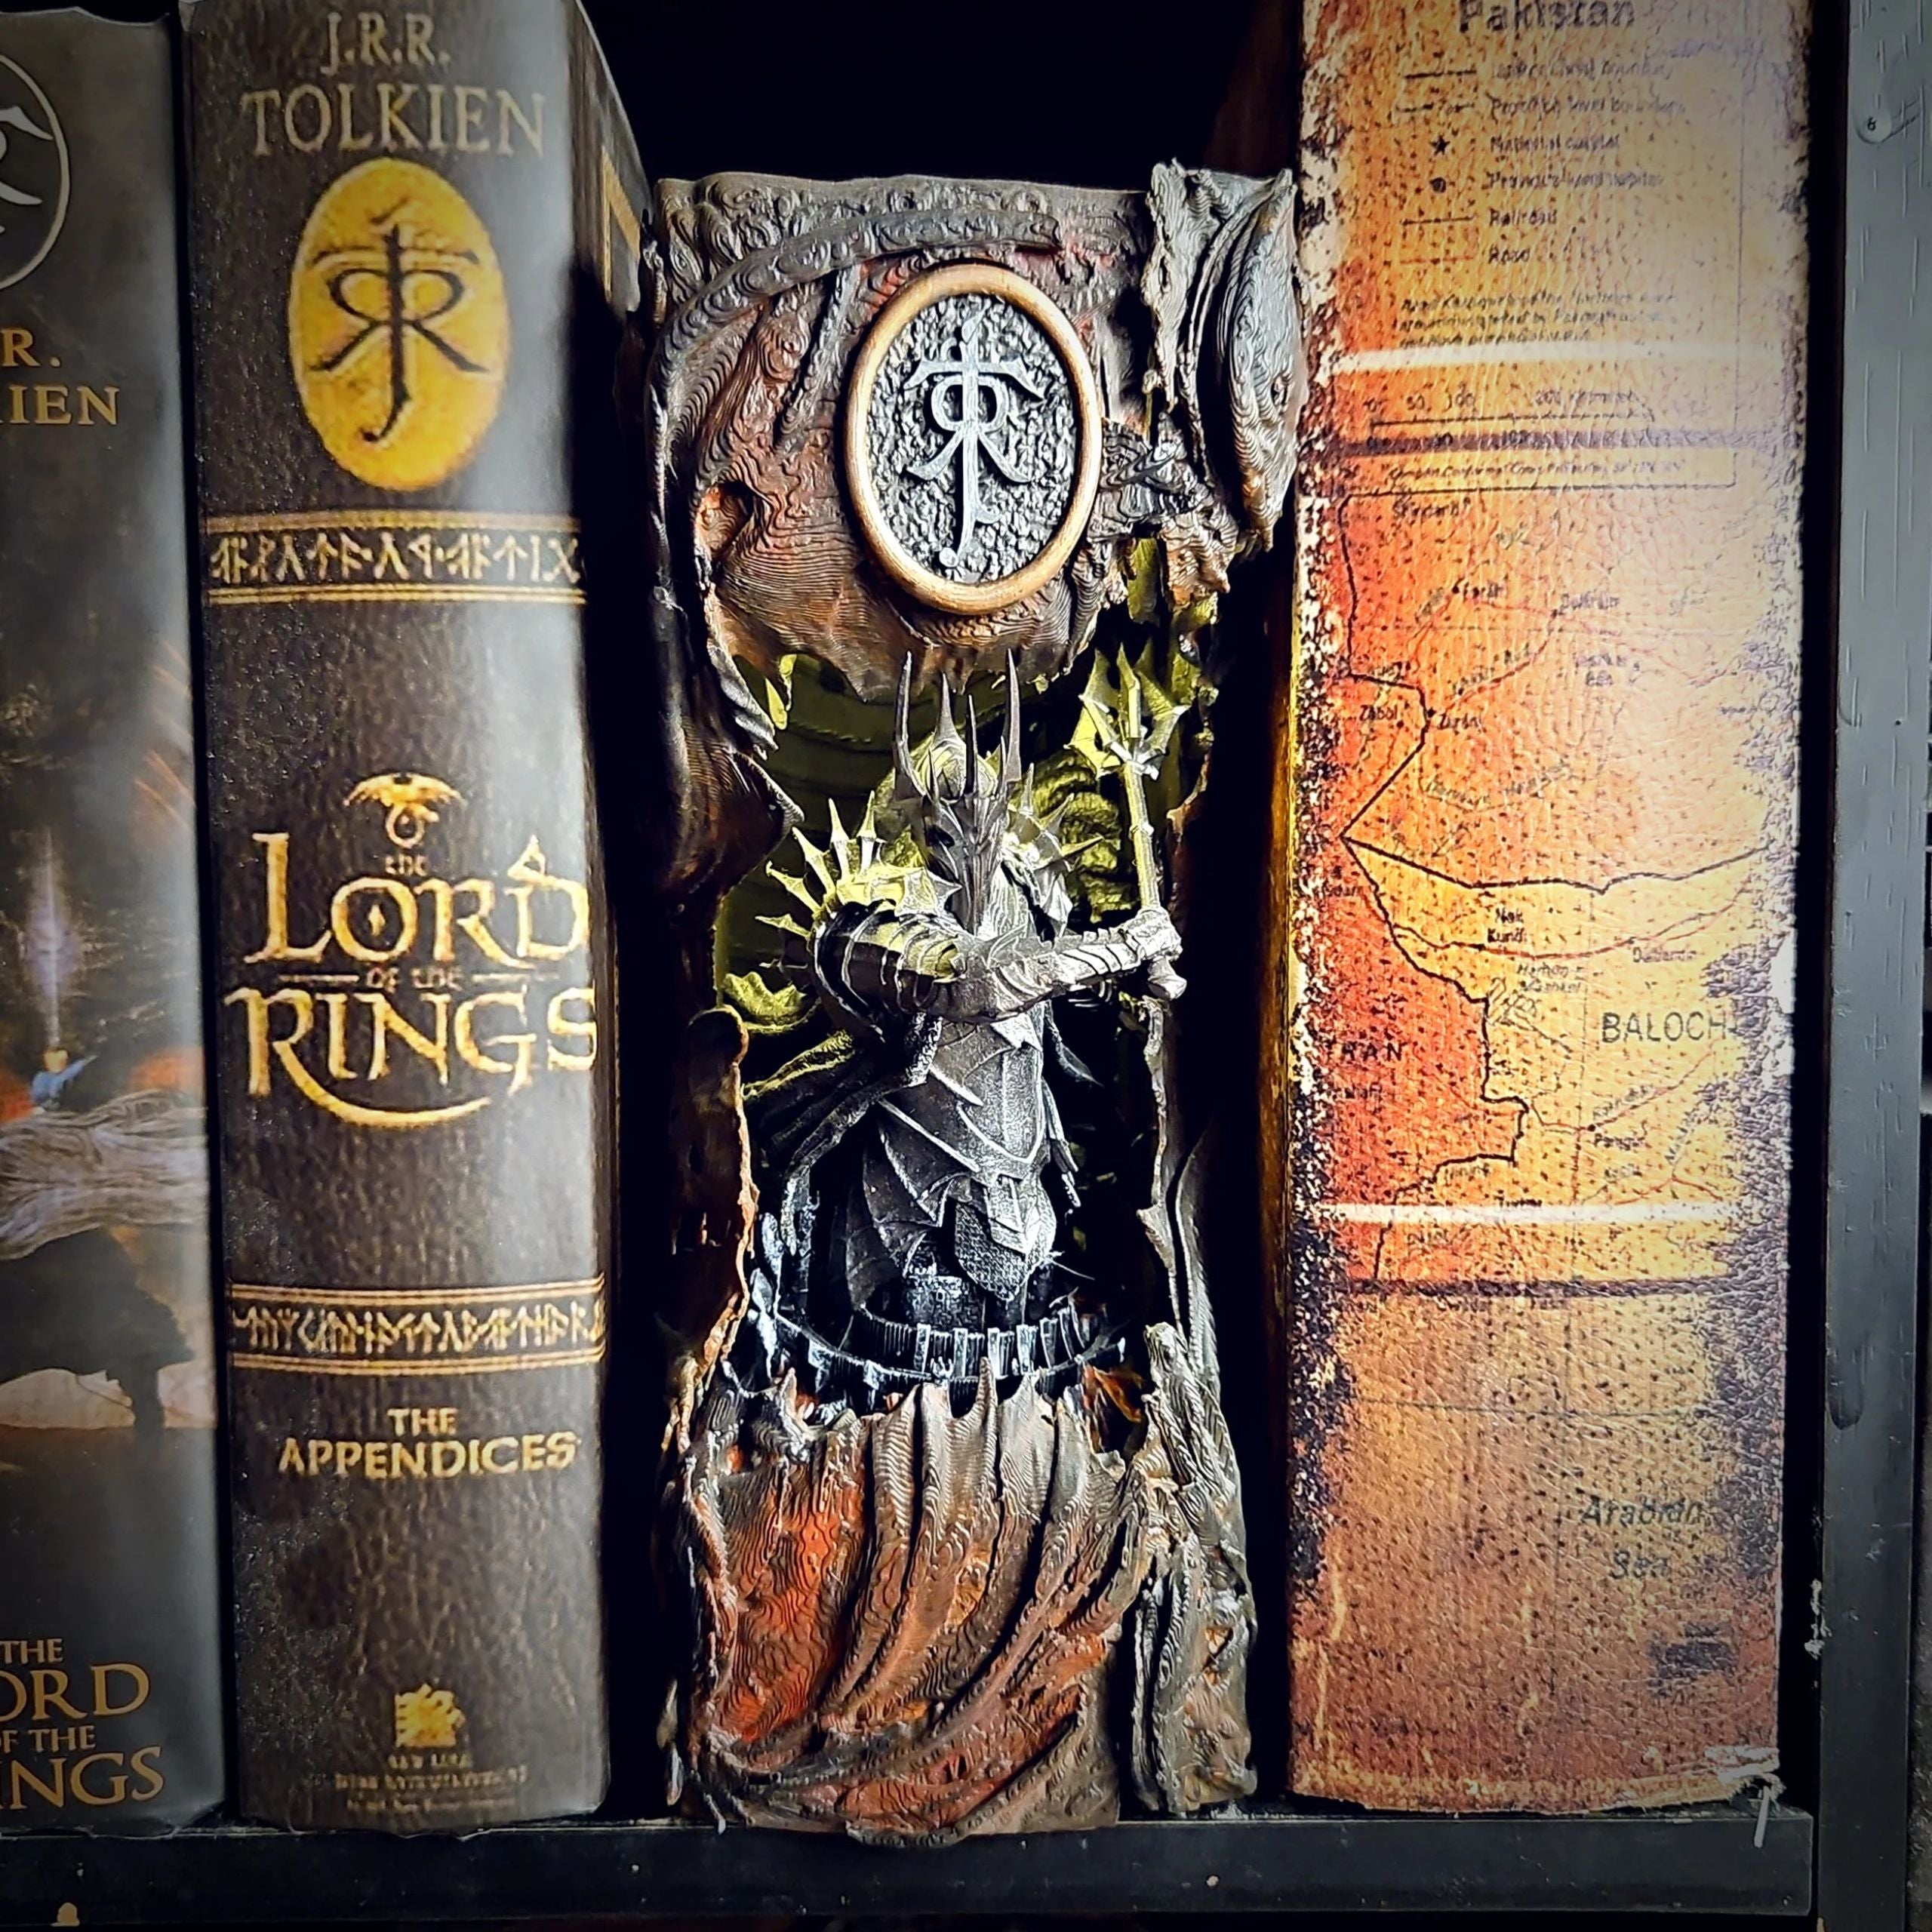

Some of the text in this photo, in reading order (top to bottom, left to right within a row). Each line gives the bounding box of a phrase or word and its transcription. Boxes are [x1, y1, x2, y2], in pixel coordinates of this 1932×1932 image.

[320, 11, 451, 76] J.R.R.
[240, 82, 546, 158] TOLKIEN
[0, 384, 120, 426] IEN
[243, 832, 591, 970] LORD
[224, 984, 598, 1125] RINGS
[386, 1407, 458, 1437] THE
[277, 1429, 583, 1480] APPENDICES
[0, 1638, 63, 1665] THE
[0, 1725, 96, 1754] F THE
[0, 1746, 165, 1810] NGS
